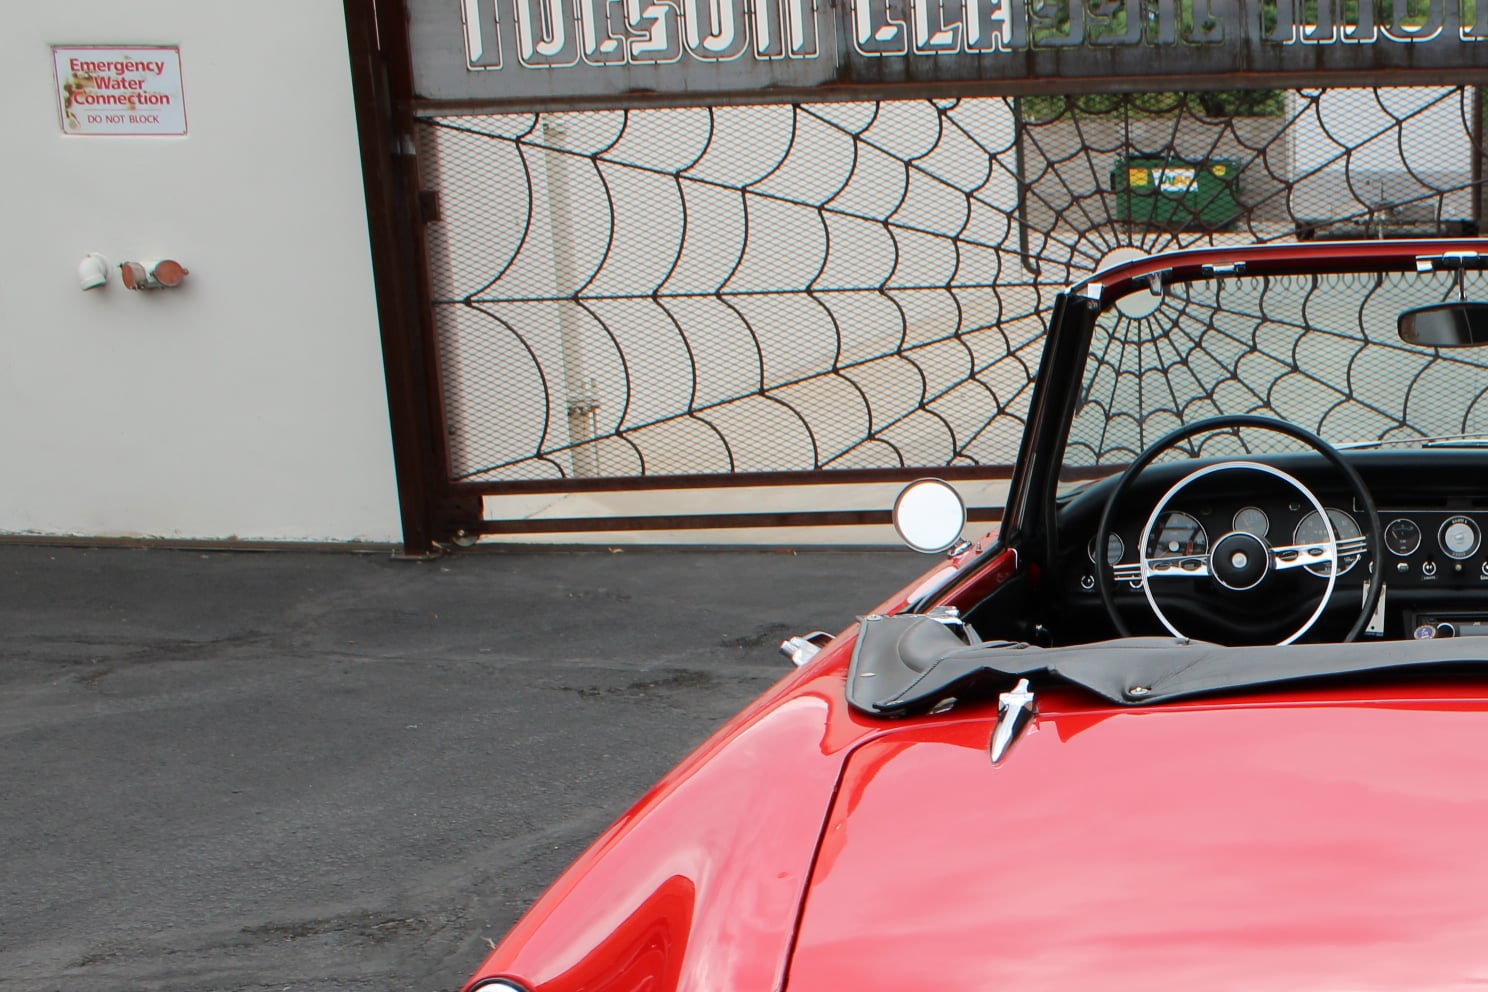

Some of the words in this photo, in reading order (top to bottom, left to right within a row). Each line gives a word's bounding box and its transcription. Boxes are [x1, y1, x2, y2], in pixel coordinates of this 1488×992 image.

[69, 58, 165, 76] Emergency
[93, 76, 146, 90] Water
[72, 90, 171, 105] Connection
[87, 115, 103, 124] DO
[105, 115, 126, 124] NOT
[129, 115, 160, 124] BLOCK
